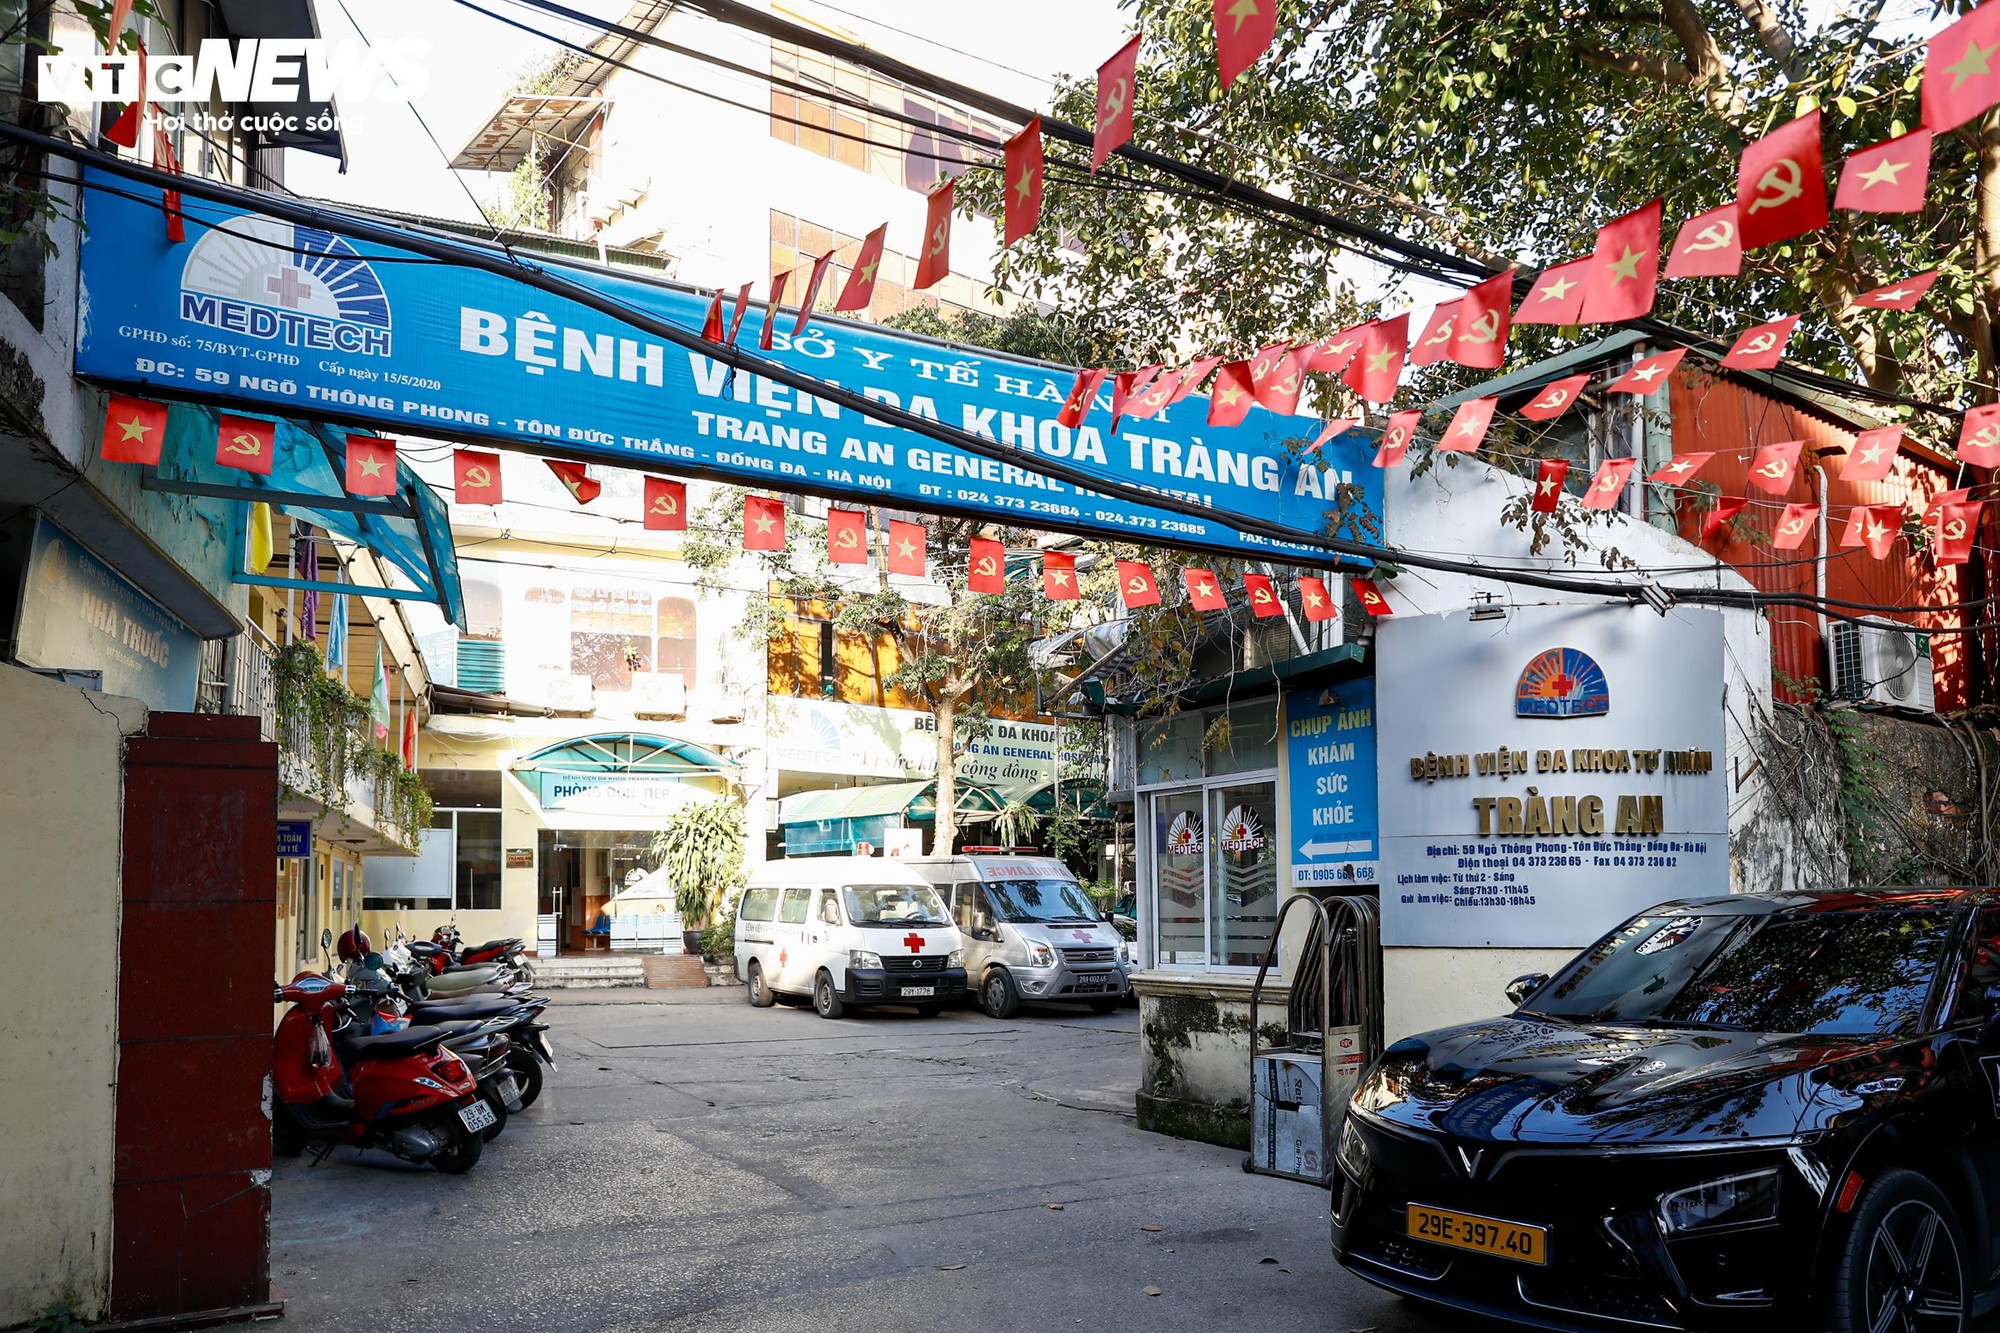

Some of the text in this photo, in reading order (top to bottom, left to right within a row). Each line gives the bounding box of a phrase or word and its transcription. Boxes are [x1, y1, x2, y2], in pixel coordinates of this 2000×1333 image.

[180, 293, 392, 359] MEDTECH
[118, 325, 300, 367] GPHĐ số: 75/BYT-GPHĐ
[318, 359, 441, 392] Cấp ngày 15/5/2020
[759, 329, 836, 359] SỞ
[853, 346, 893, 371] Y
[910, 358, 981, 388] TẾ
[994, 374, 1066, 405] HÀ
[460, 306, 664, 388] BỆNH
[688, 350, 840, 420] VIỆN
[962, 403, 1109, 465] KHOA
[1122, 432, 1280, 493] TRÀNG
[1294, 462, 1353, 501] AN
[135, 357, 185, 379] ĐC:
[194, 368, 230, 386] 59
[239, 374, 298, 396] NGÕ
[306, 385, 395, 412] THÔNG
[402, 401, 490, 427] PHONG
[514, 418, 561, 438] TÔN
[568, 426, 615, 446] ĐỨC
[621, 435, 695, 460] THẮNG
[715, 450, 775, 473] ĐỐNG
[779, 459, 808, 477] ĐA
[826, 467, 853, 483] HÀ
[858, 472, 892, 491] NỘI
[691, 410, 1064, 493] TRANG AN GENERAL
[919, 484, 942, 497] ĐT
[957, 489, 990, 504] 024
[994, 494, 1026, 510] 373
[1030, 500, 1081, 519] 23684
[1095, 510, 1157, 529] 024.373
[1160, 518, 1206, 536] 23685
[1239, 531, 1268, 546] FAX:
[122, 615, 170, 670] THUỐC
[998, 725, 1017, 740] ĐA
[1022, 728, 1056, 744] KHOA
[1291, 707, 1372, 739] CHỤP ẢNH
[983, 745, 1000, 756] AN
[1003, 747, 1053, 761] GENERAL
[1308, 742, 1355, 766] KHÁM
[1410, 745, 1713, 784] BỆNH VIỆN ĐA KHOA TƯ NHÂN
[961, 760, 998, 781] cộng
[1002, 759, 1039, 783] đồng
[1316, 773, 1349, 795] SỨC
[1312, 800, 1354, 826] KHỎE
[1472, 786, 1664, 838] TRÀNG AN
[1221, 838, 1270, 851] MEDTECH
[1462, 845, 1475, 855] 59
[1478, 844, 1497, 857] Ngõ
[1501, 843, 1532, 855] Thông
[1535, 842, 1567, 854] Phong
[1573, 841, 1591, 852] Tôn
[1593, 840, 1612, 852] Đức
[1298, 870, 1311, 881] ĐT:
[1313, 869, 1334, 881] 0905
[1356, 867, 1375, 879] 668
[1458, 858, 1480, 871] Điện
[1483, 856, 1509, 870] thoại
[1512, 856, 1526, 867] 04
[1528, 856, 1547, 867] 373
[1549, 856, 1567, 866] 236
[1569, 856, 1582, 867] 65
[1594, 856, 1610, 867] Fax
[1613, 856, 1626, 867] 04
[1628, 856, 1645, 867] 373
[1647, 856, 1665, 867] 236
[1666, 857, 1677, 867] 82
[1397, 874, 1413, 885] Lịch
[1414, 874, 1429, 884] làm
[1431, 873, 1451, 885] việc:
[1453, 872, 1463, 883] Từ
[1465, 872, 1479, 882] thứ
[1480, 872, 1486, 882] 2
[1493, 872, 1515, 883] Sáng
[1504, 885, 1529, 895] 11h45
[1431, 894, 1453, 905] việc:
[468, 1112, 494, 1131] 055.65
[1418, 1212, 1532, 1256] 29E-397.40
